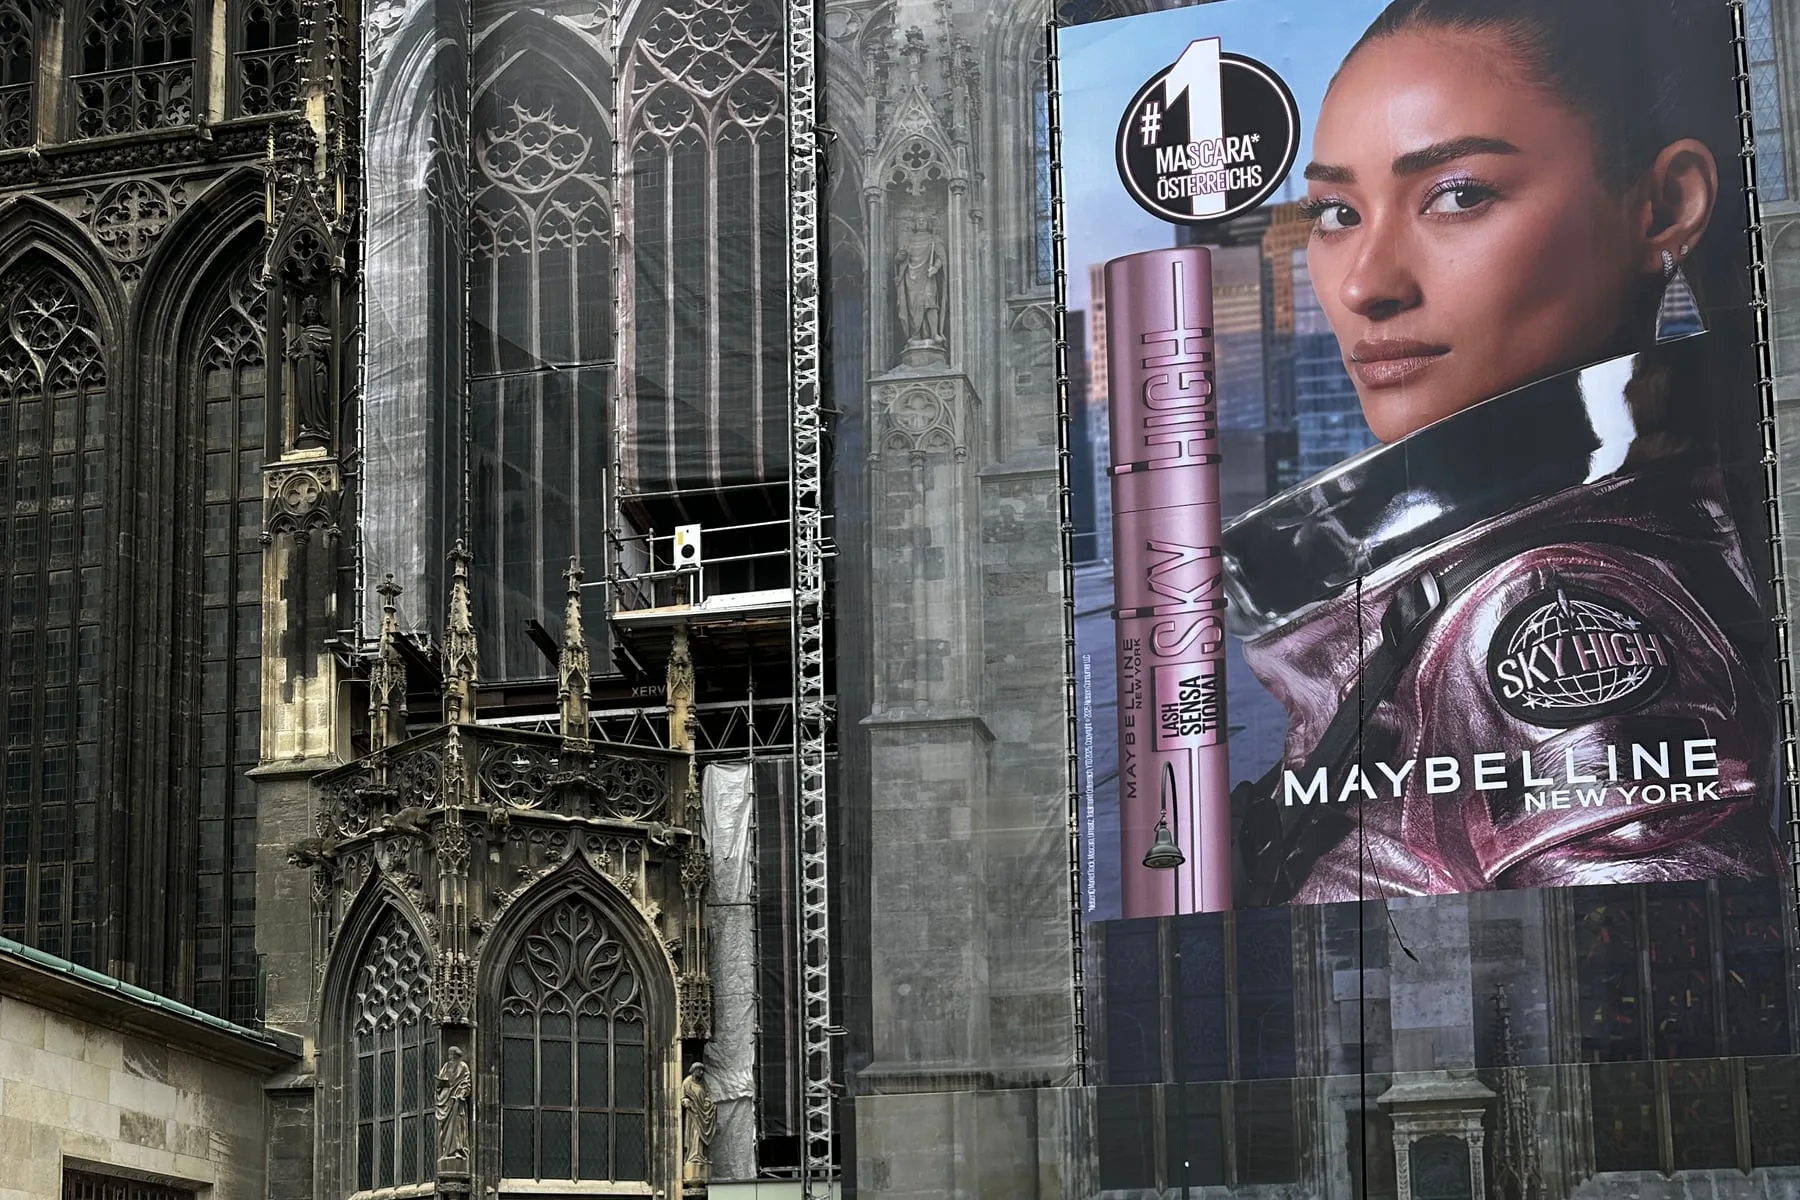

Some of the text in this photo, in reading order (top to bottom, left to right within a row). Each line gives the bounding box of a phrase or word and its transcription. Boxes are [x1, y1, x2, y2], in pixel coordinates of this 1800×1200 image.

[1157, 165, 1262, 200] ÖSTERREICHS
[1141, 326, 1224, 657] SKY HIGH
[1133, 638, 1141, 678] YORK
[1497, 631, 1669, 700] SKY HIGH
[632, 685, 666, 697] XERV
[1179, 675, 1201, 736] SENSA
[1123, 638, 1137, 799] MAYBELLINE
[1162, 702, 1179, 738] LASH
[1283, 738, 1720, 806] MAYBELLINE
[1524, 781, 1721, 812] NEW YORK
